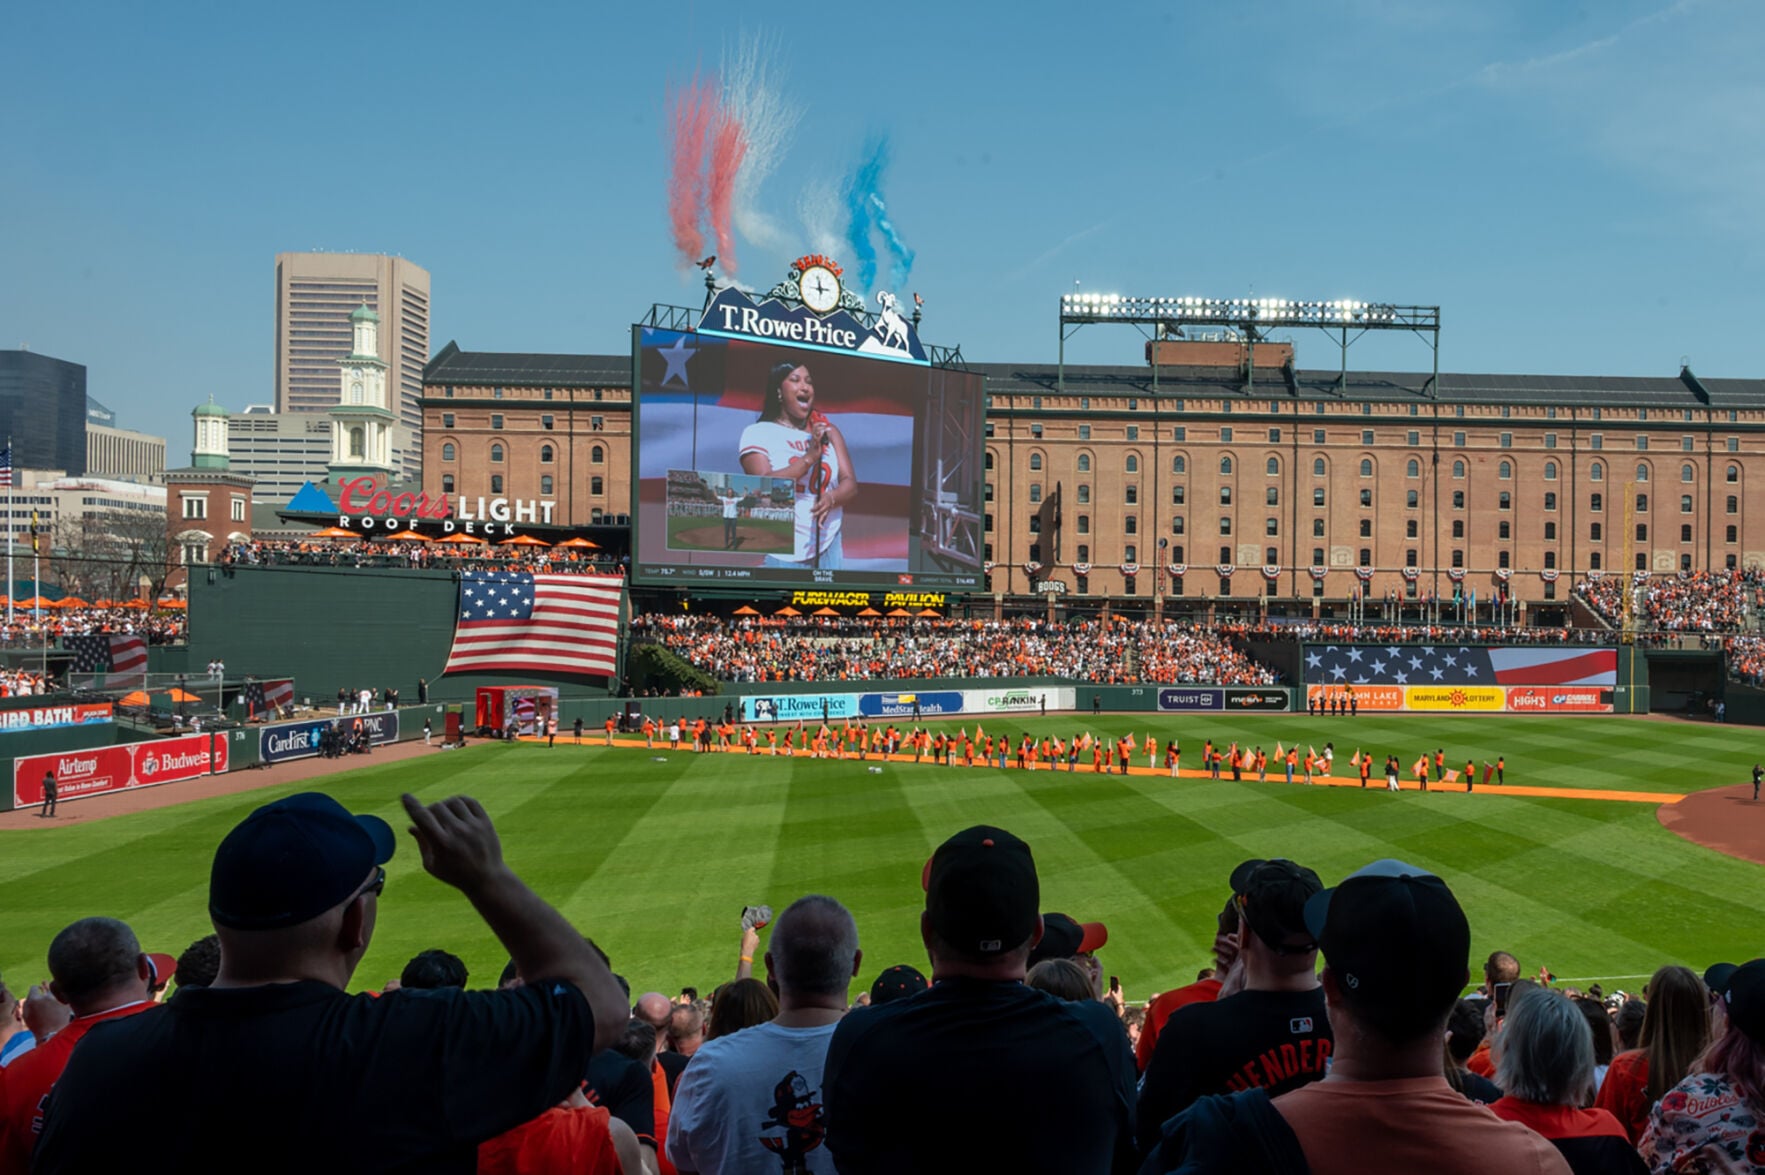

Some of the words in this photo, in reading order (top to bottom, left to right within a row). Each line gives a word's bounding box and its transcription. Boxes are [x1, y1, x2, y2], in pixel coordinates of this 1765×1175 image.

[804, 317, 857, 348] Price
[338, 475, 452, 519] Coors
[459, 496, 556, 524] LIGHT
[340, 516, 418, 530] ROOF
[444, 520, 515, 536] DECK
[884, 593, 945, 607] PAVILION
[1167, 695, 1199, 703] TRUIST
[1376, 690, 1398, 700] LAKE
[1413, 694, 1450, 702] MARYLAND
[1465, 694, 1496, 702] LOTTERY
[1513, 695, 1546, 708] HIGH'S
[819, 697, 846, 710] Pice
[0, 711, 30, 729] IRD
[33, 708, 73, 726] BATH
[363, 717, 383, 733] PNC
[235, 731, 246, 741] 376
[268, 730, 311, 754] CareFirst
[57, 757, 97, 776] Airtemp
[1687, 1093, 1738, 1115] Orioles
